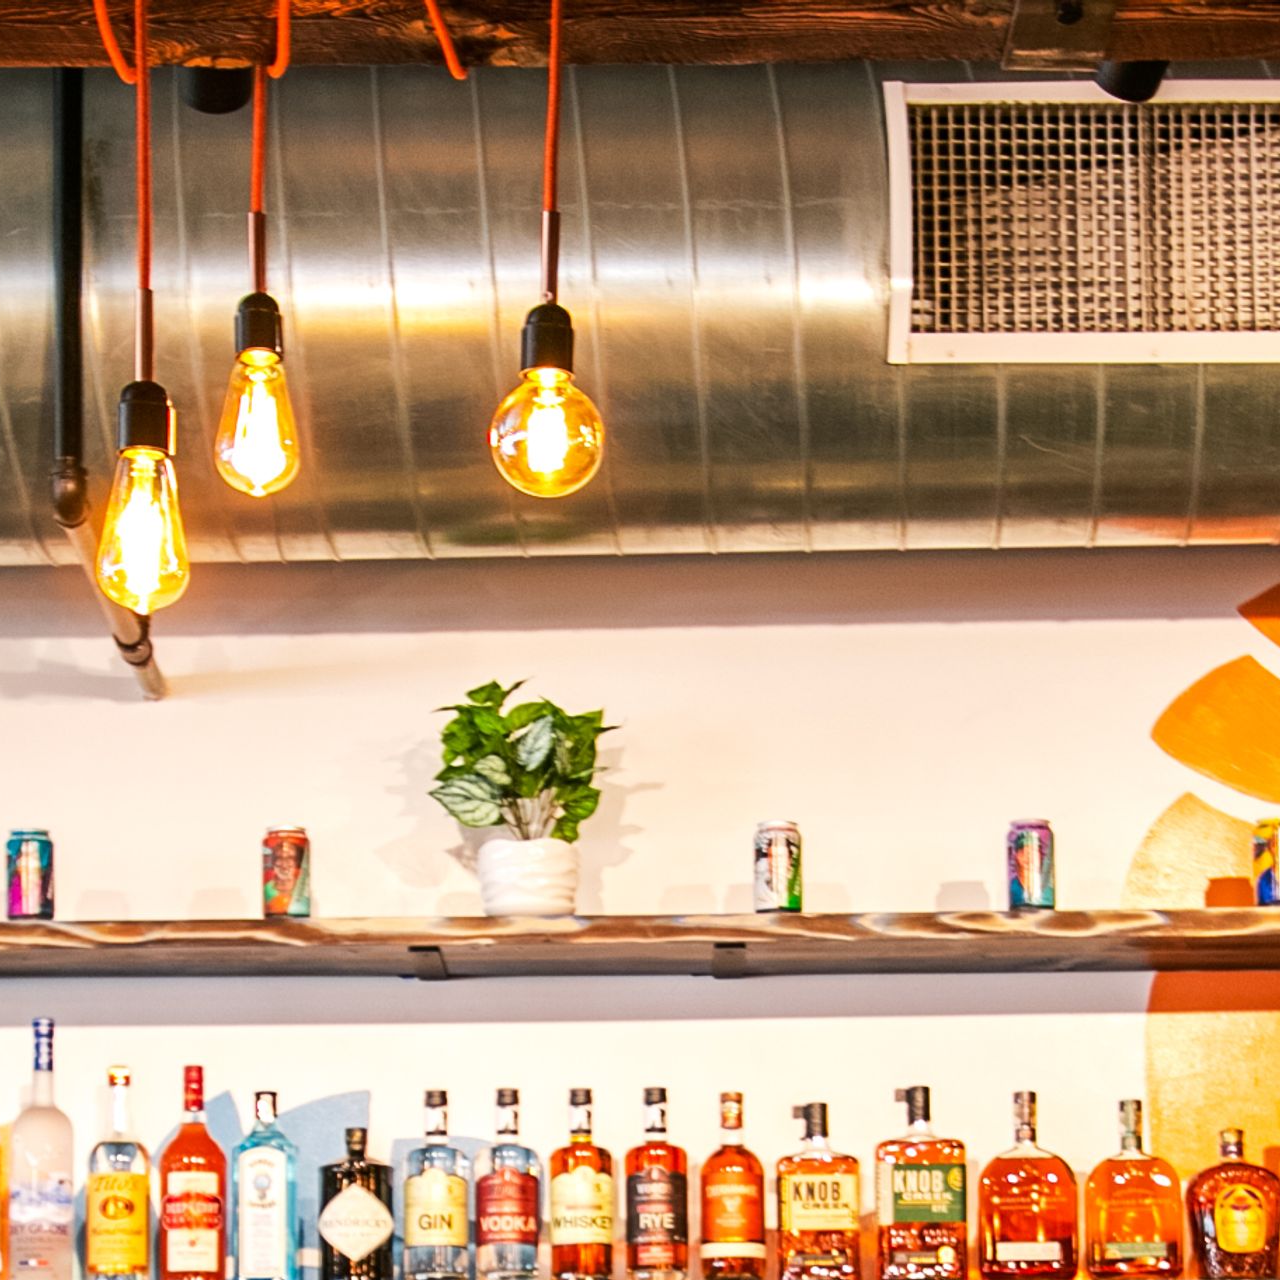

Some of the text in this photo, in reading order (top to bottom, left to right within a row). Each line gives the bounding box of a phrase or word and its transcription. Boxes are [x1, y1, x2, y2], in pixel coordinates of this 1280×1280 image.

[892, 1170, 944, 1192] KNOB
[793, 1182, 840, 1200] KNOB
[418, 1214, 452, 1230] GIN
[480, 1215, 537, 1232] VODKA
[639, 1213, 675, 1229] RYE
